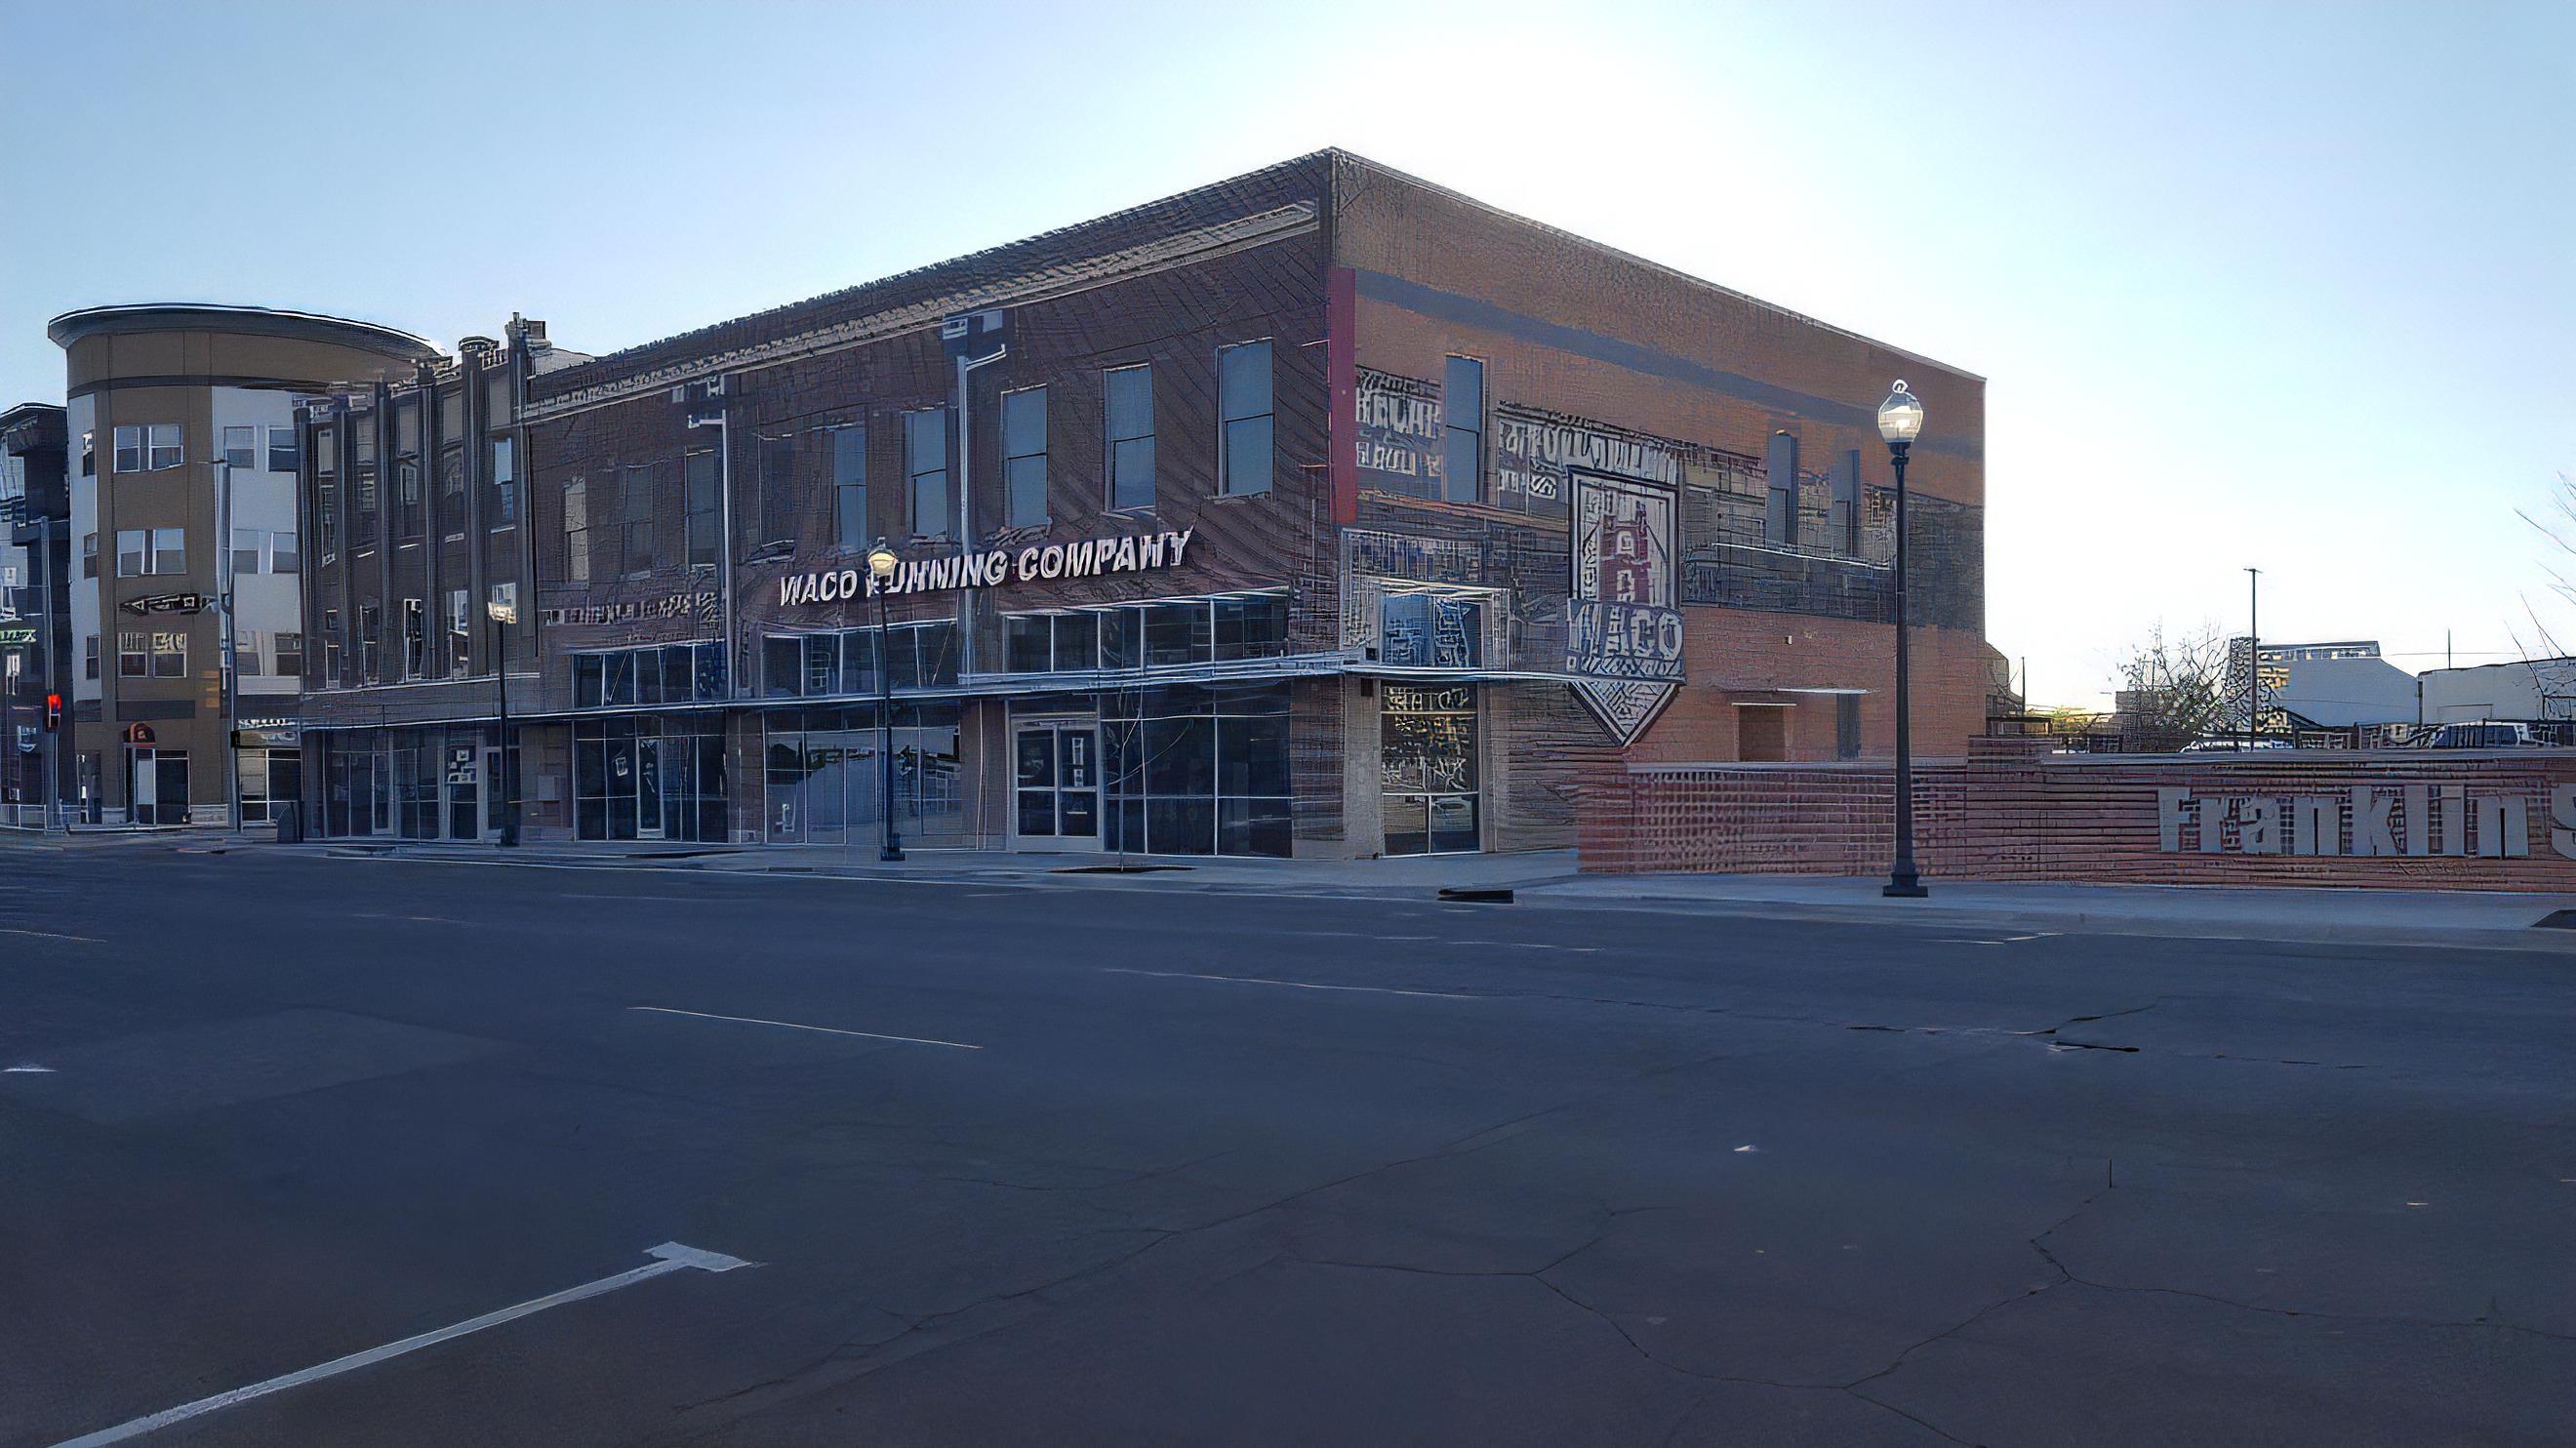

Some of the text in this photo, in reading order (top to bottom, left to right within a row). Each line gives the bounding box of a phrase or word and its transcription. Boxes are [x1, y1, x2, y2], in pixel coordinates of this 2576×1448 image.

[780, 570, 857, 605] WACO
[1019, 530, 1192, 578] COMPANY
[1567, 602, 1684, 662] WACO
[2157, 784, 2529, 857] Franklin
